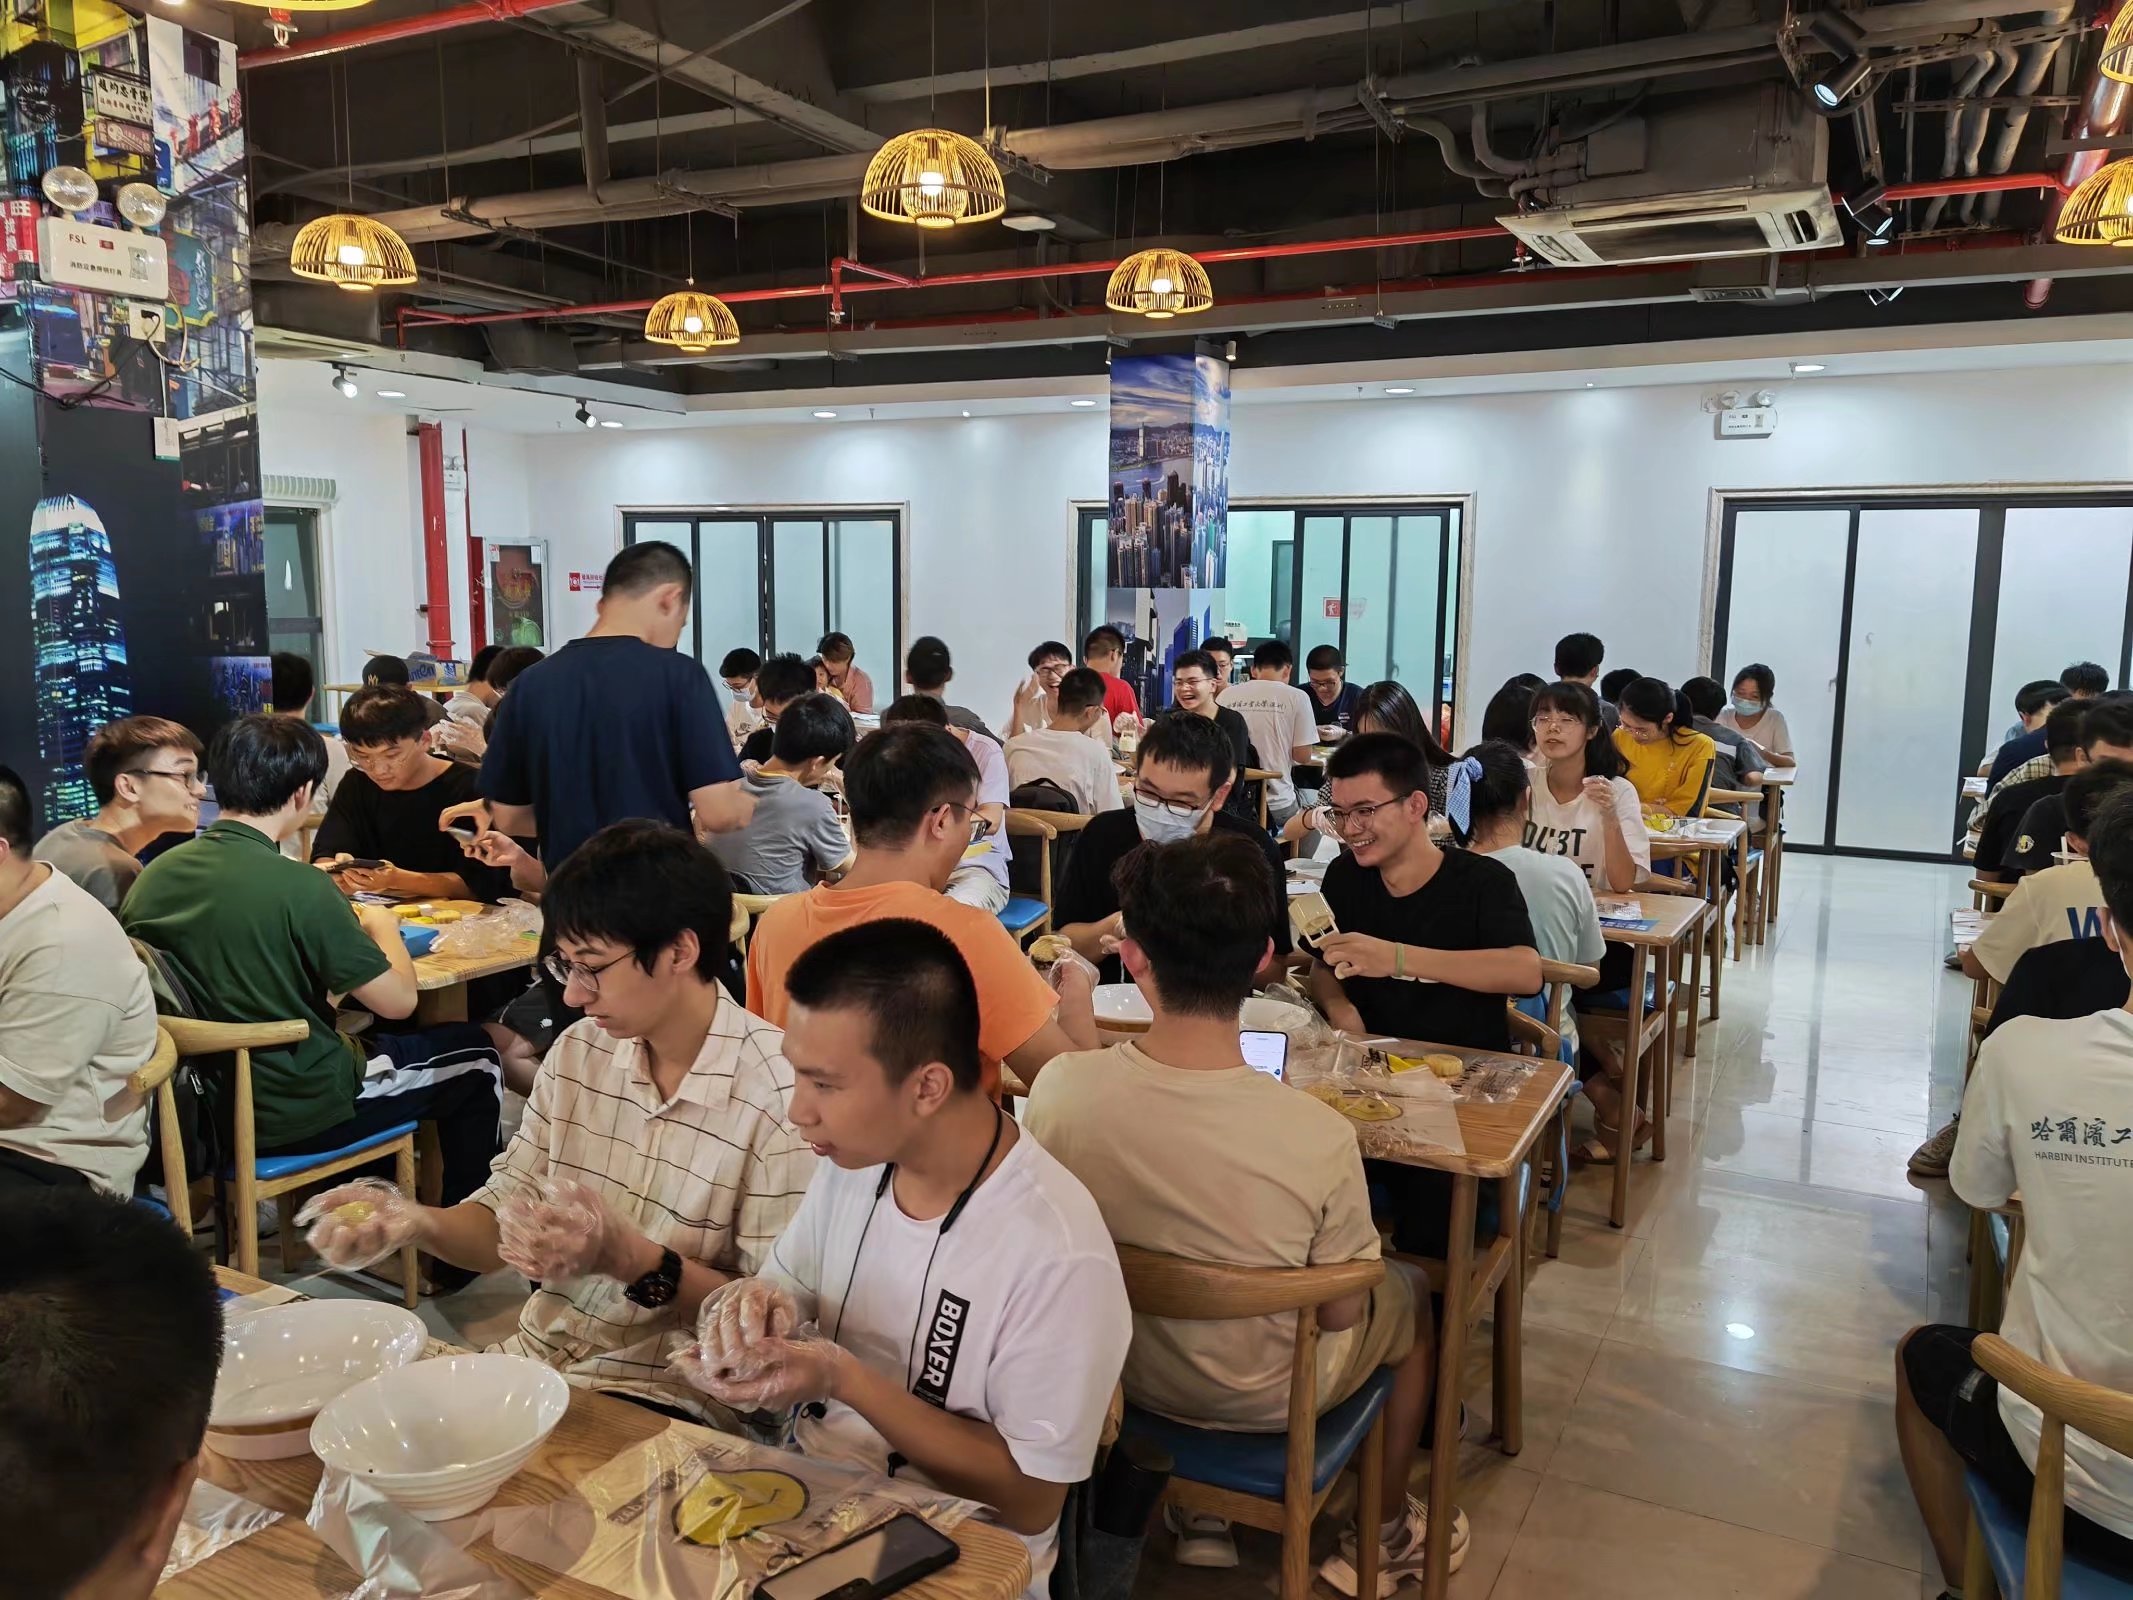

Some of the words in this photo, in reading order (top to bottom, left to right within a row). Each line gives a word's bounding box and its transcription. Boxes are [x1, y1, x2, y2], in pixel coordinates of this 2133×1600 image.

[69, 233, 87, 245] FSL
[2035, 1151, 2073, 1163] HARBIN
[922, 1298, 963, 1387] BOXER
